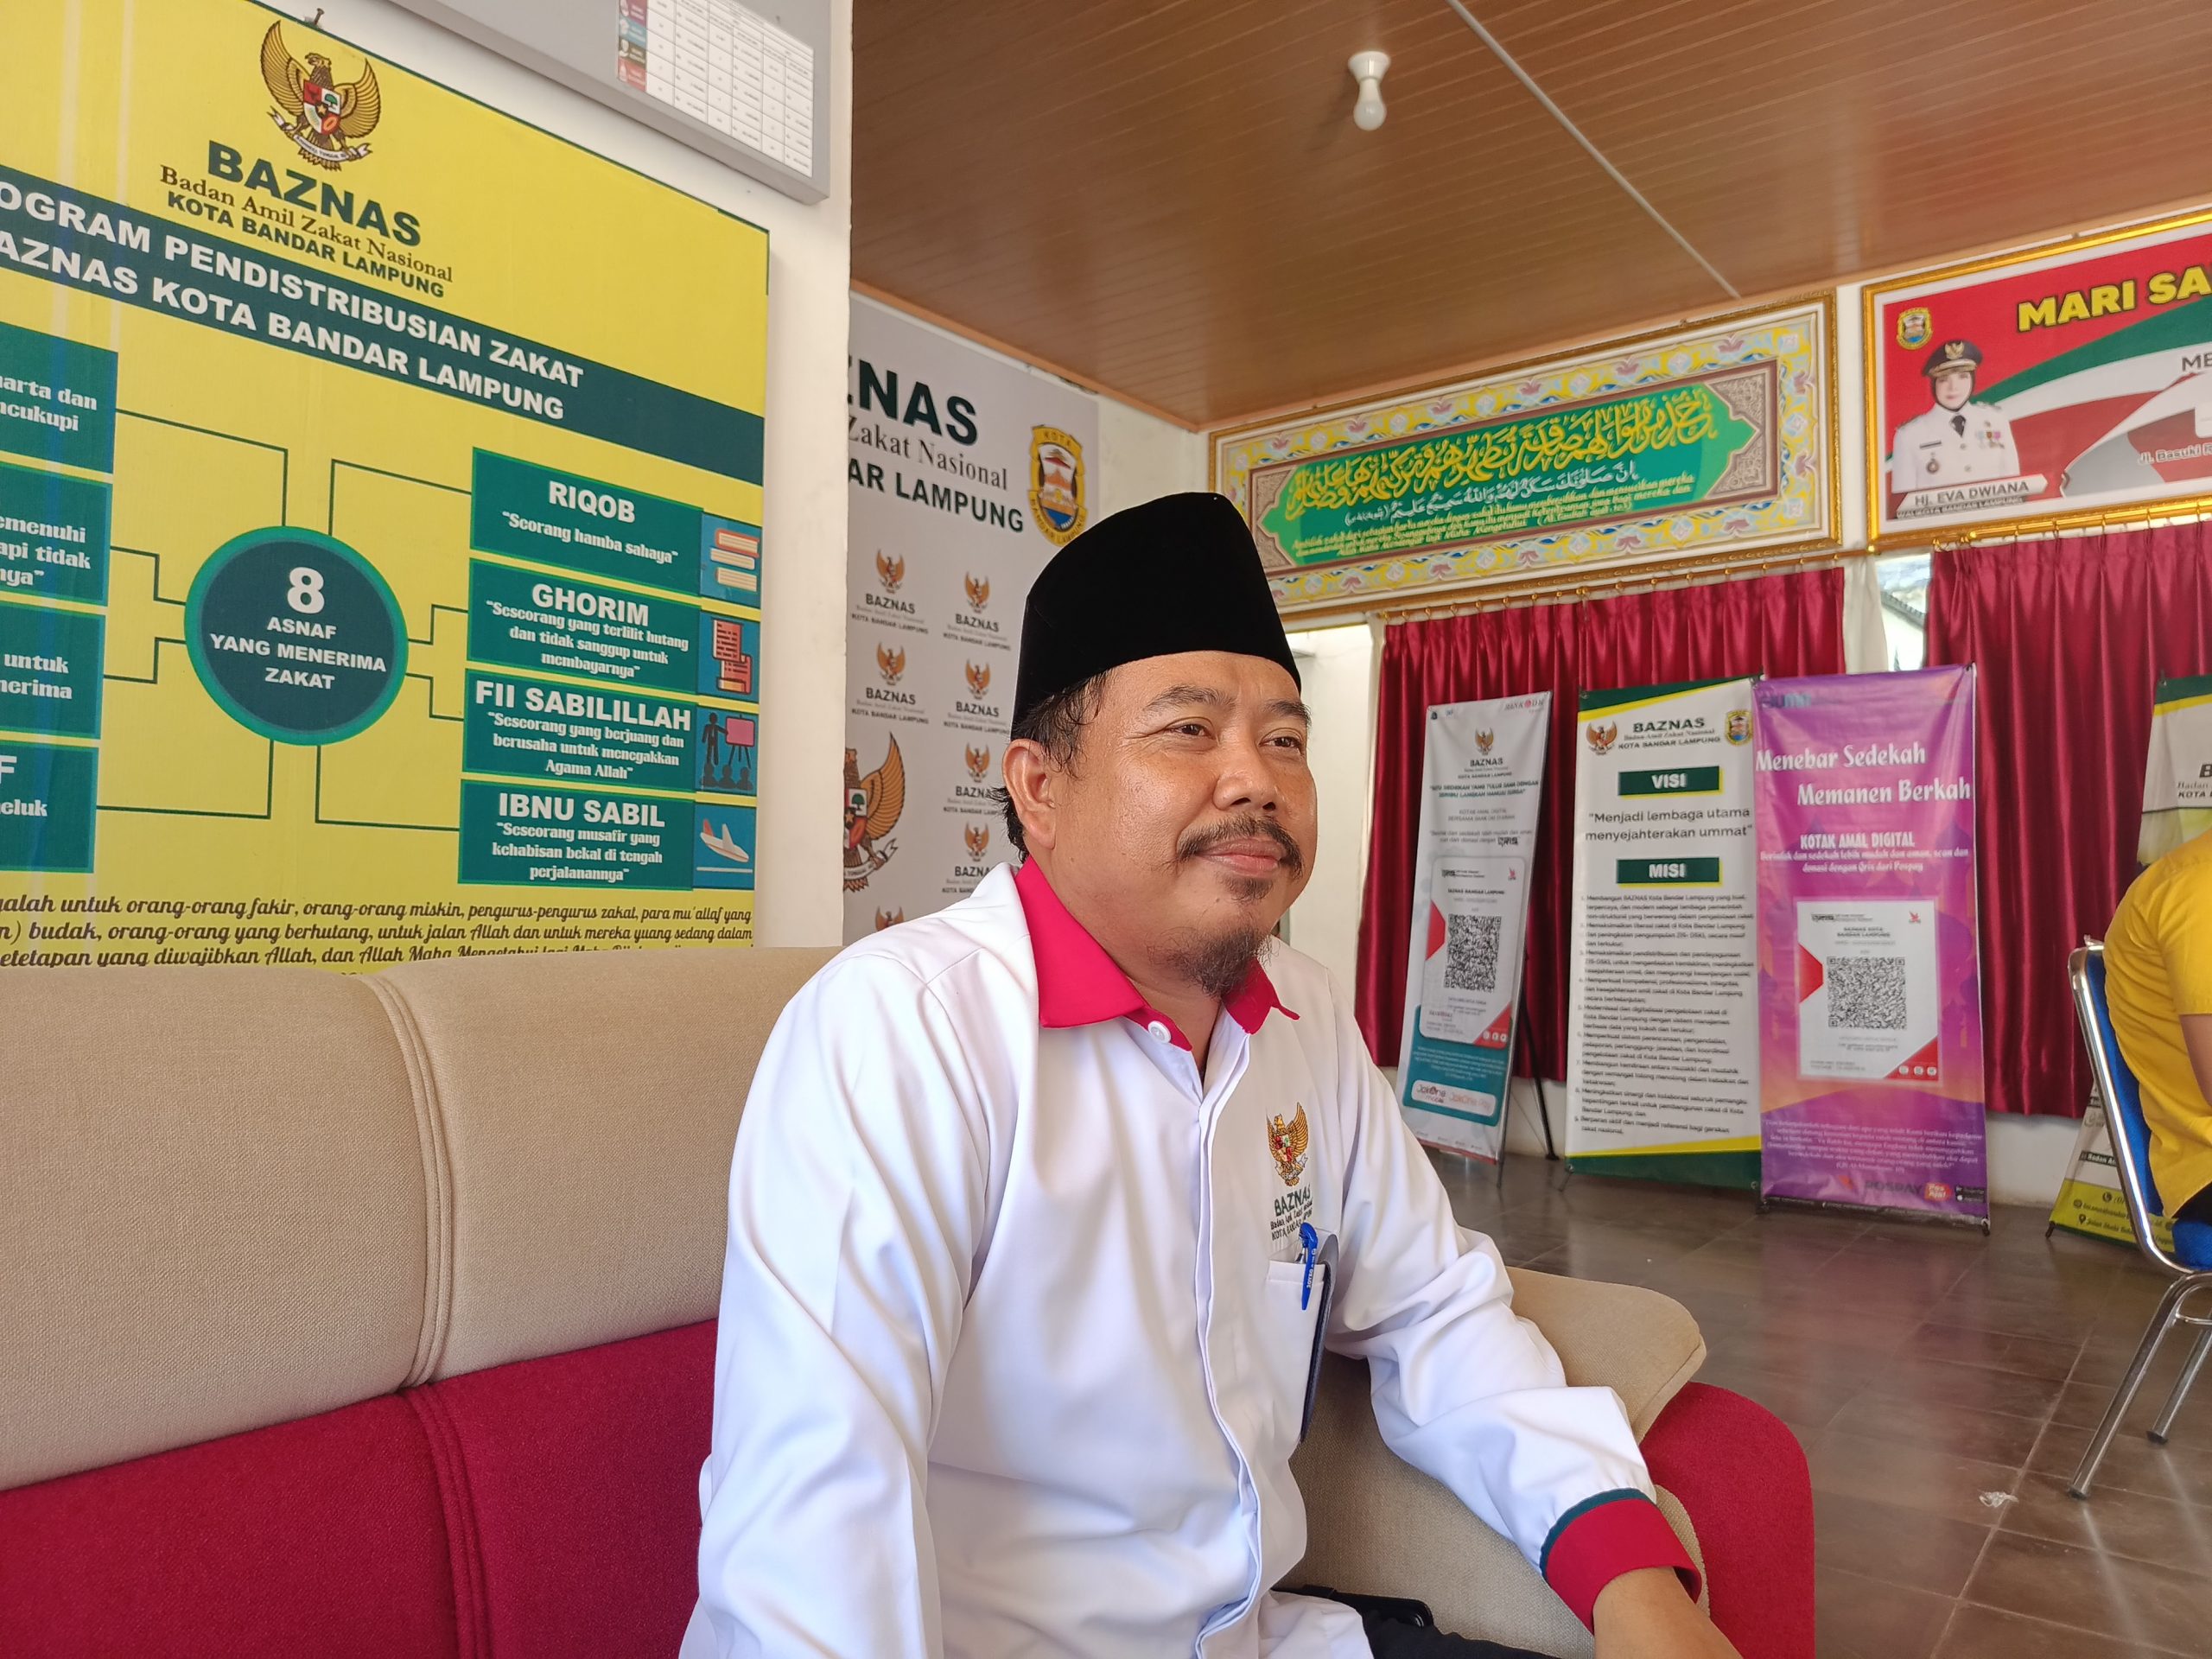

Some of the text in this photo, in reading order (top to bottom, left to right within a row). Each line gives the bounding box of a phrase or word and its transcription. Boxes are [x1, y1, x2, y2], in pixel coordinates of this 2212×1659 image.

[207, 140, 422, 247] BAZNAS
[160, 165, 453, 283] Badan Amil Zakat Nasional
[168, 192, 445, 298] KOTA BANDAR LAMPUNG
[0, 181, 583, 388] OGRAM PENDISTRIBUSIAN ZAKAT
[2018, 279, 2136, 332] MARI
[0, 231, 564, 420] AZNAS KOTA BANDAR LAMPUNG
[58, 388, 97, 410] dan
[848, 355, 978, 446] NAS
[849, 415, 1007, 491] Zakat Nasional
[549, 481, 635, 524] RIQOB
[896, 472, 1023, 532] LAMPUNG
[1937, 491, 1964, 503] EVA
[1969, 480, 2030, 499] DWIANA
[575, 530, 622, 552] hamba
[35, 546, 91, 569] tidak
[287, 567, 325, 613] 8
[532, 583, 649, 626] GHORIM
[865, 593, 916, 614] BAZNAS
[267, 617, 337, 639] ASNAF
[955, 613, 999, 632] BAZNAS
[510, 626, 669, 664] dan tidak sanggup untuk
[569, 619, 601, 636] yang
[646, 631, 690, 652] hutang
[4, 653, 69, 673] untuk
[210, 633, 386, 672] YANG MENERIMA
[265, 667, 335, 690] ZAKAT
[475, 680, 691, 731] FII SABILILLAH
[866, 687, 916, 705] BAZNAS
[956, 701, 1000, 717] BAZNAS
[569, 724, 601, 741] yang
[605, 726, 660, 748] berjuang
[662, 733, 684, 748] dan
[1632, 717, 1706, 734] BAZNAS
[493, 733, 679, 766] berusaha untuk menegakkan
[1618, 737, 1721, 750] KOTA BANDAR LAMPUNG
[544, 759, 591, 777] Agama
[1756, 741, 1925, 772] Menebar Sedekah
[1651, 773, 1687, 789] VISI
[1797, 777, 1970, 805] Memanen Berkah
[499, 792, 665, 827] IBNU SABIL
[1647, 809, 1703, 823] lembaga
[1707, 808, 1750, 819] utama
[577, 827, 627, 844] musafir
[630, 832, 660, 847] yang
[1585, 827, 1695, 842] menyejahterakan
[1801, 831, 1916, 849] KOTAK AMAL DIGITAL
[492, 842, 663, 865] kehabisan bekal di tengah
[955, 866, 990, 877] BAZNA
[1649, 863, 1686, 878] MISI
[60, 896, 122, 913] untuk
[126, 899, 246, 919] orang-orang
[246, 898, 299, 919] fakir,
[303, 902, 406, 921] orang-orang
[410, 902, 465, 919] miskin,
[467, 905, 598, 922] pengurus-pengurus
[601, 906, 639, 922] zakat,
[641, 908, 671, 923] para
[724, 910, 752, 925] yang
[29, 921, 102, 942] budak,
[108, 925, 231, 944] orang-orang
[234, 926, 281, 944] yang
[284, 924, 373, 944] berhutang,
[378, 925, 423, 940] untuk
[423, 924, 467, 944] jalan
[470, 924, 511, 941] Allah
[513, 925, 541, 939] dan
[543, 925, 582, 939] untuk
[584, 925, 632, 939] mereka
[633, 929, 672, 944] yuang
[675, 926, 715, 944] sedang
[717, 926, 753, 940] dalam
[97, 951, 149, 967] yang
[154, 947, 260, 967] diwajibkan
[264, 946, 317, 965] Allah,
[321, 947, 354, 963] dan
[359, 946, 404, 964] Allah
[1274, 1183, 1311, 1217] BAZNAS
